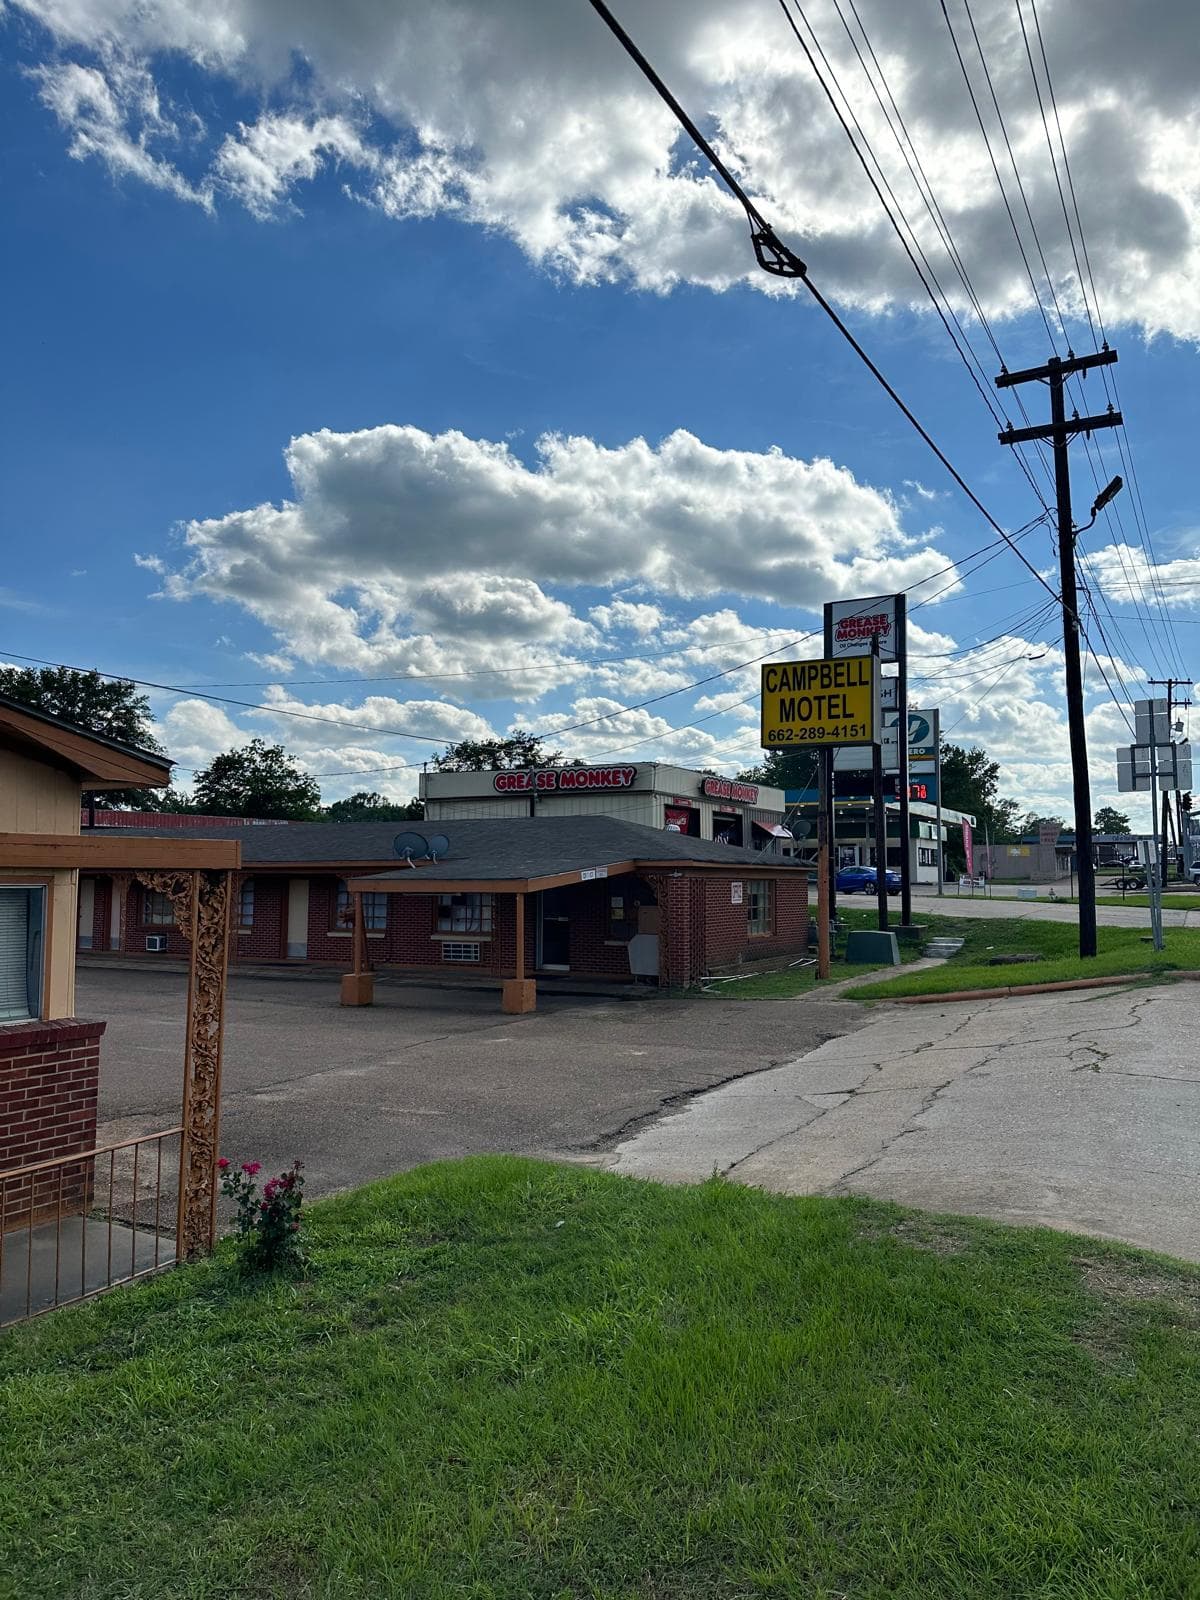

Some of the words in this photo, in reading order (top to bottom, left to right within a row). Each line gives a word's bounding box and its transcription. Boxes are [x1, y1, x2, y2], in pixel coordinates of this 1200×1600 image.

[836, 624, 891, 641] MONKEY
[839, 615, 888, 629] GREASE
[766, 661, 869, 693] CAMPBELL
[780, 694, 854, 723] MOTEL
[768, 724, 866, 742] 662-289-4151
[495, 772, 555, 792] GREASE
[559, 766, 634, 790] MONKEY
[705, 779, 731, 798] GREASE
[731, 784, 759, 802] MONKEY
